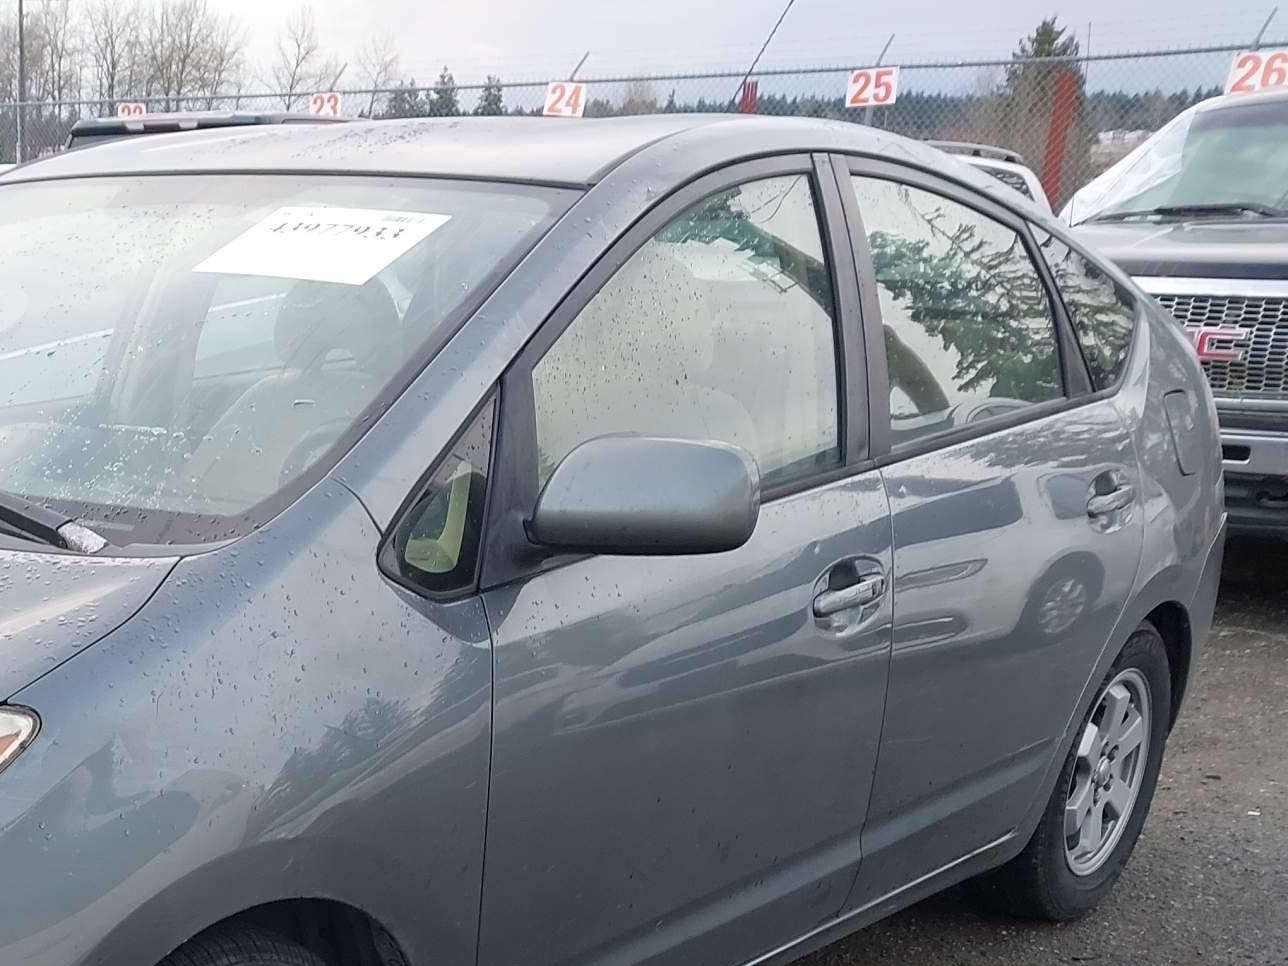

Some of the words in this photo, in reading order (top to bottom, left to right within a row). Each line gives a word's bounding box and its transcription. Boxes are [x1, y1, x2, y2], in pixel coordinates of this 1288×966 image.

[849, 69, 894, 104] 25
[1230, 52, 1288, 92] 26
[313, 94, 340, 117] 23
[546, 83, 582, 114] 24
